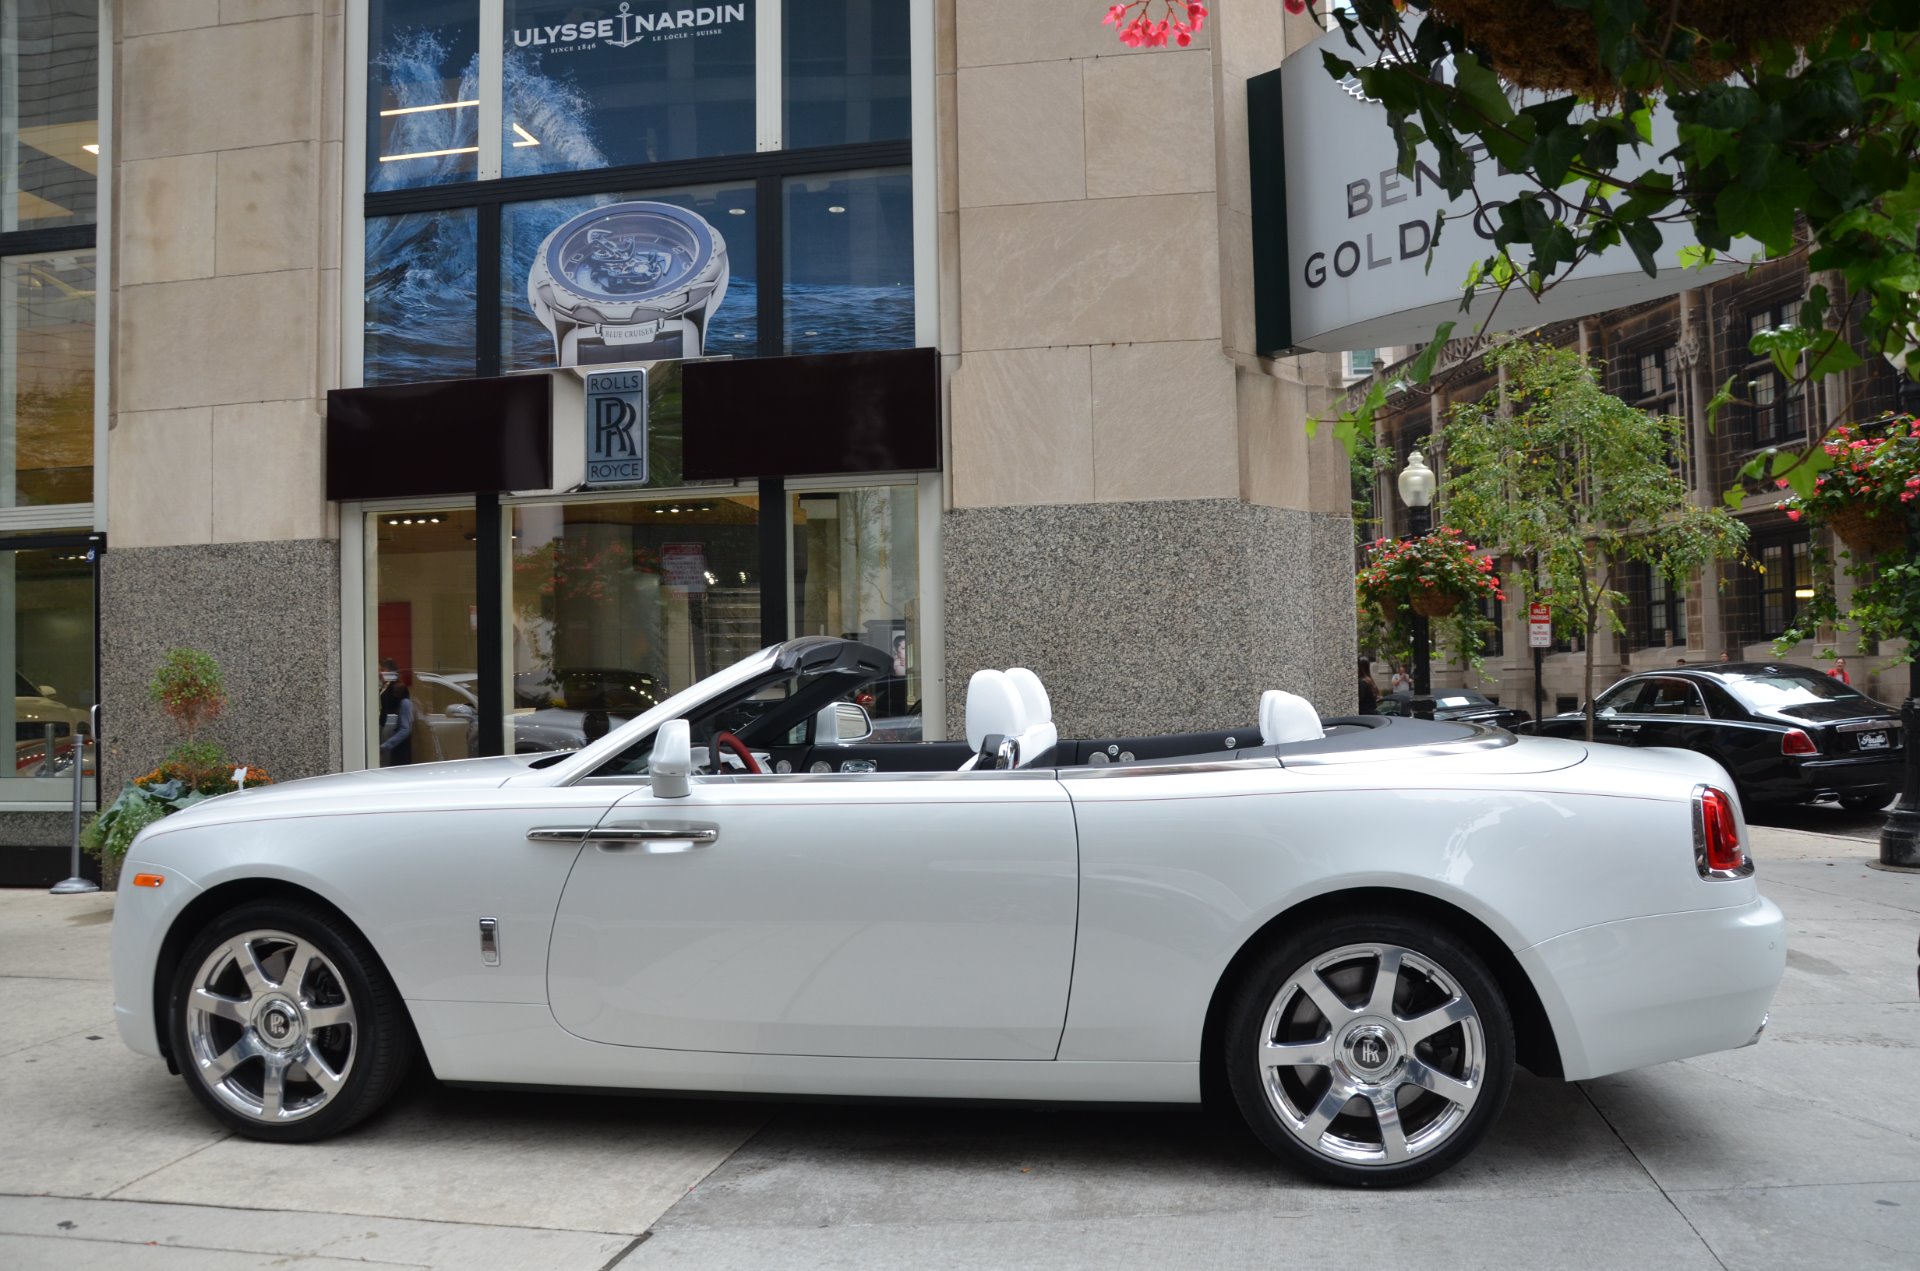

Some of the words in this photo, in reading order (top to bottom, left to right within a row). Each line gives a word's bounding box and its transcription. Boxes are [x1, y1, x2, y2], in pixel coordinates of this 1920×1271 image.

[514, 19, 613, 47] ULYSSE
[635, 3, 745, 34] NARDIN
[664, 32, 688, 41] LOCLE
[696, 28, 722, 37] SUISSE
[550, 46, 574, 54] SINCE
[577, 42, 597, 51] 1846
[1304, 219, 1431, 289] GOLD
[605, 330, 623, 338] BLUE
[625, 327, 655, 338] CRUISER
[591, 375, 639, 391] ROLLS
[591, 463, 639, 478] ROYCE
